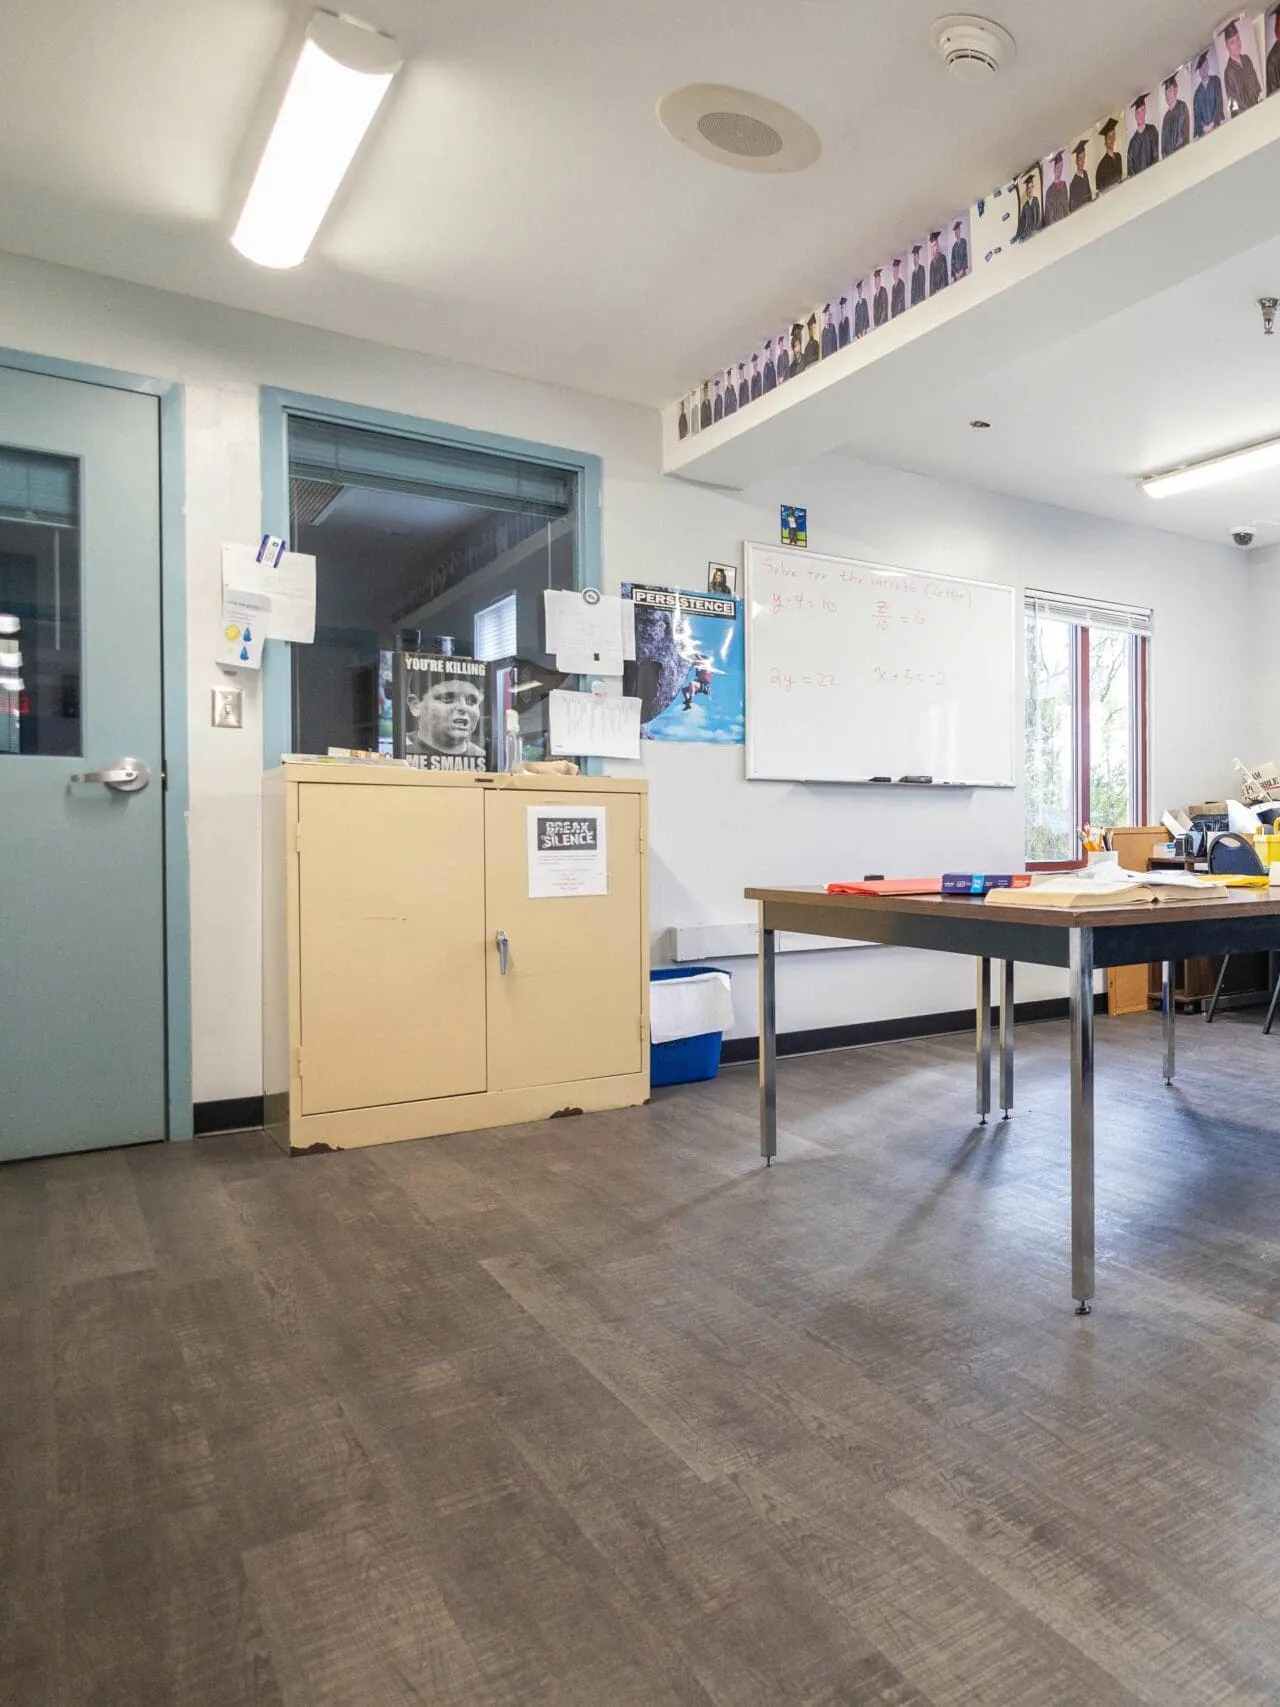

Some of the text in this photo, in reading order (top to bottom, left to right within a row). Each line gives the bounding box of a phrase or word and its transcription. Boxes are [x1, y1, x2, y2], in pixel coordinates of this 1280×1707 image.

[636, 592, 731, 613] PERSSTENCE
[405, 658, 486, 676] YOU'RE KILLING
[405, 754, 486, 771] ME SMALLS
[545, 821, 589, 834] BREAK
[541, 830, 595, 848] SILENCE
